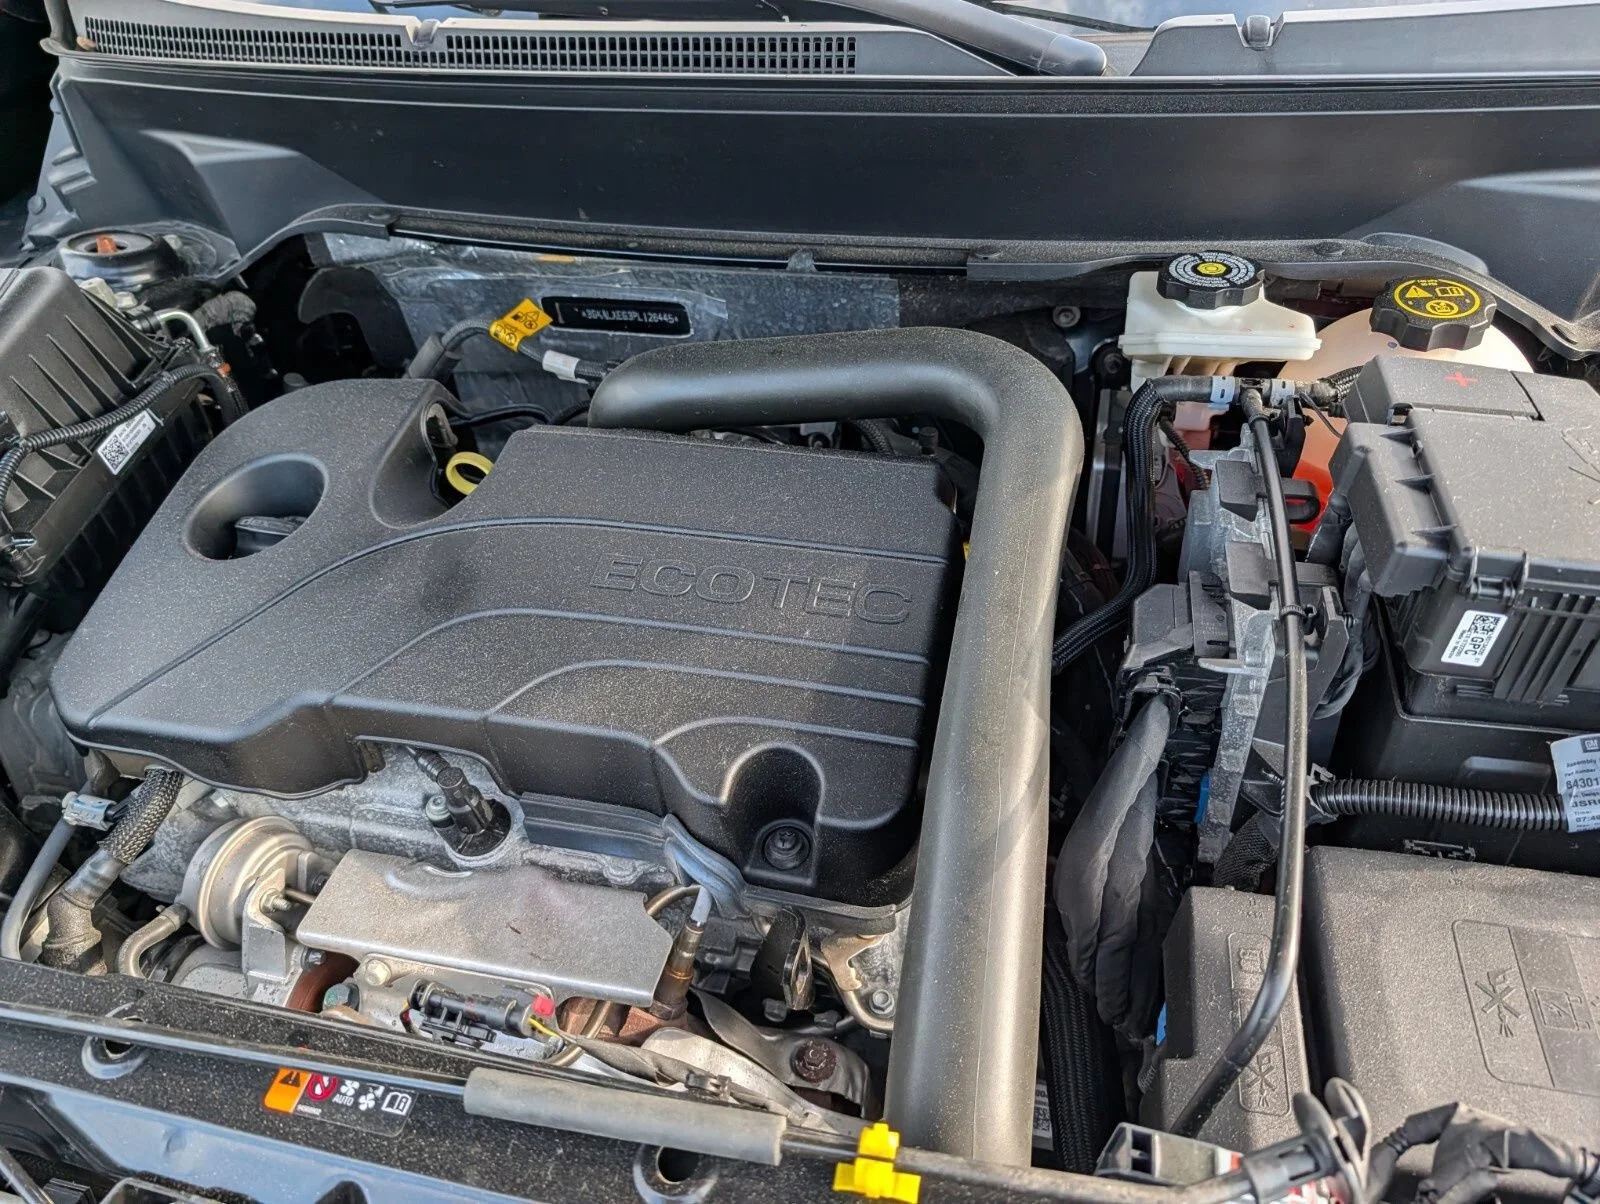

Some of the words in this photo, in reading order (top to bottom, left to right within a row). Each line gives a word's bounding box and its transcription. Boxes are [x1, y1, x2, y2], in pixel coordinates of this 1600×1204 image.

[590, 552, 913, 624] ECOTEC
[1464, 636, 1484, 655] GPC
[332, 1093, 355, 1107] AUTO
